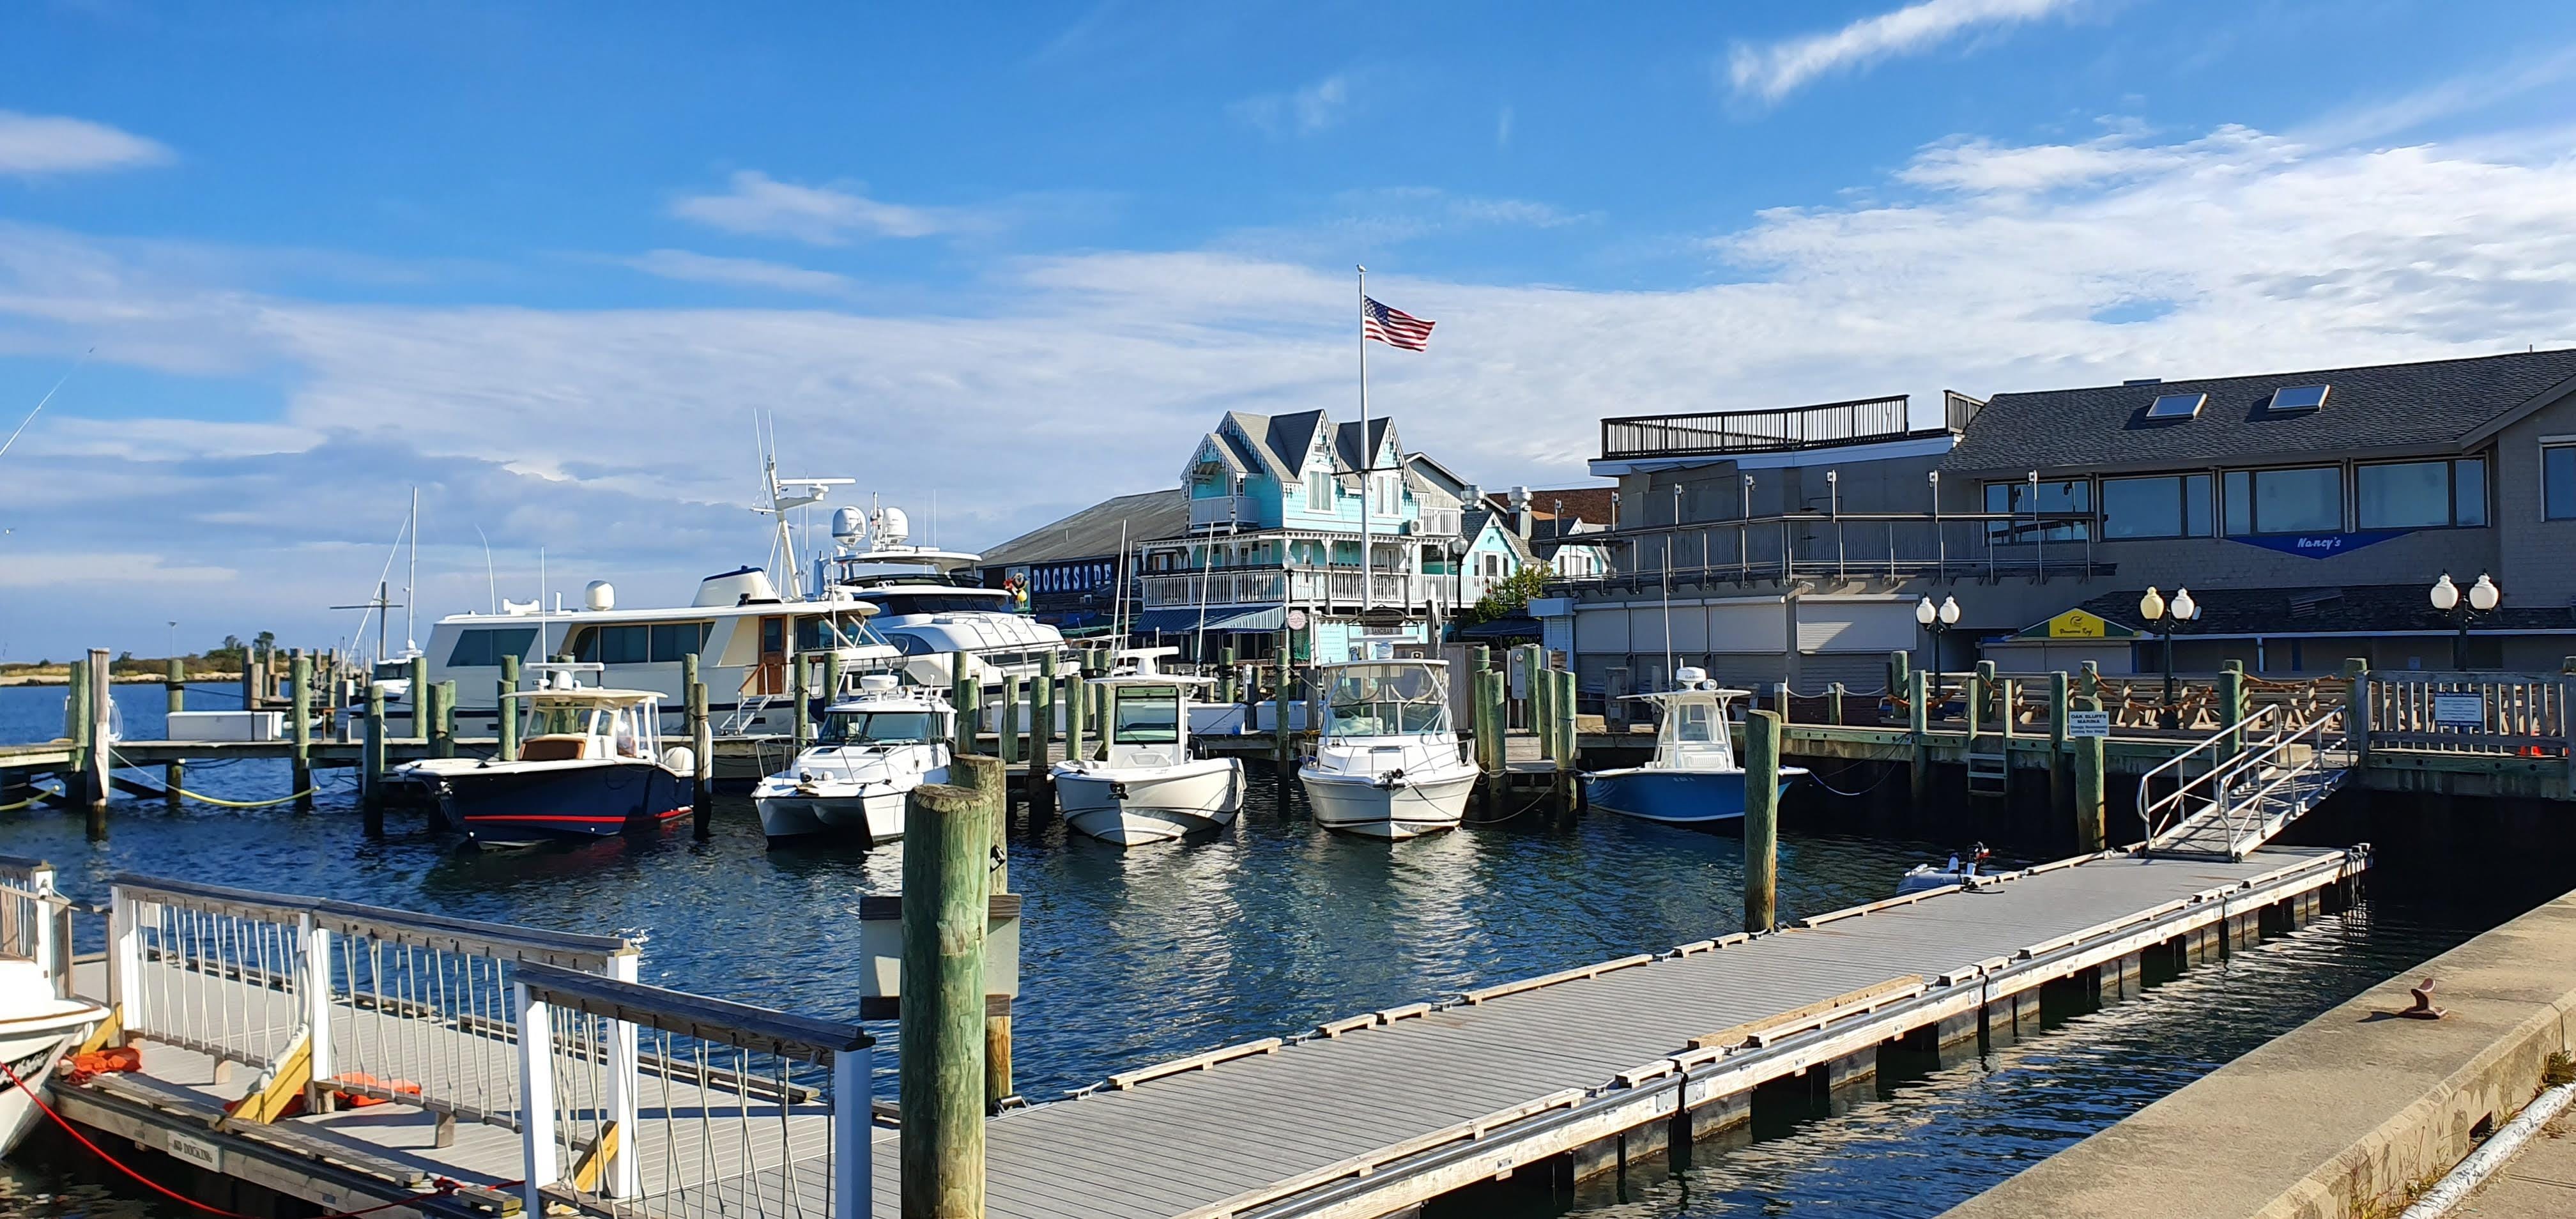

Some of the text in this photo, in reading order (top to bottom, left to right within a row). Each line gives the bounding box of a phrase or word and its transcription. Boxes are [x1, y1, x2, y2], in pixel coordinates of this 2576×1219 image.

[2297, 536, 2342, 550] Nancy's
[1033, 564, 1112, 592] DOCKSIDE
[1371, 627, 1394, 635] SANDBAR
[173, 1139, 213, 1163] NO DOCKING
